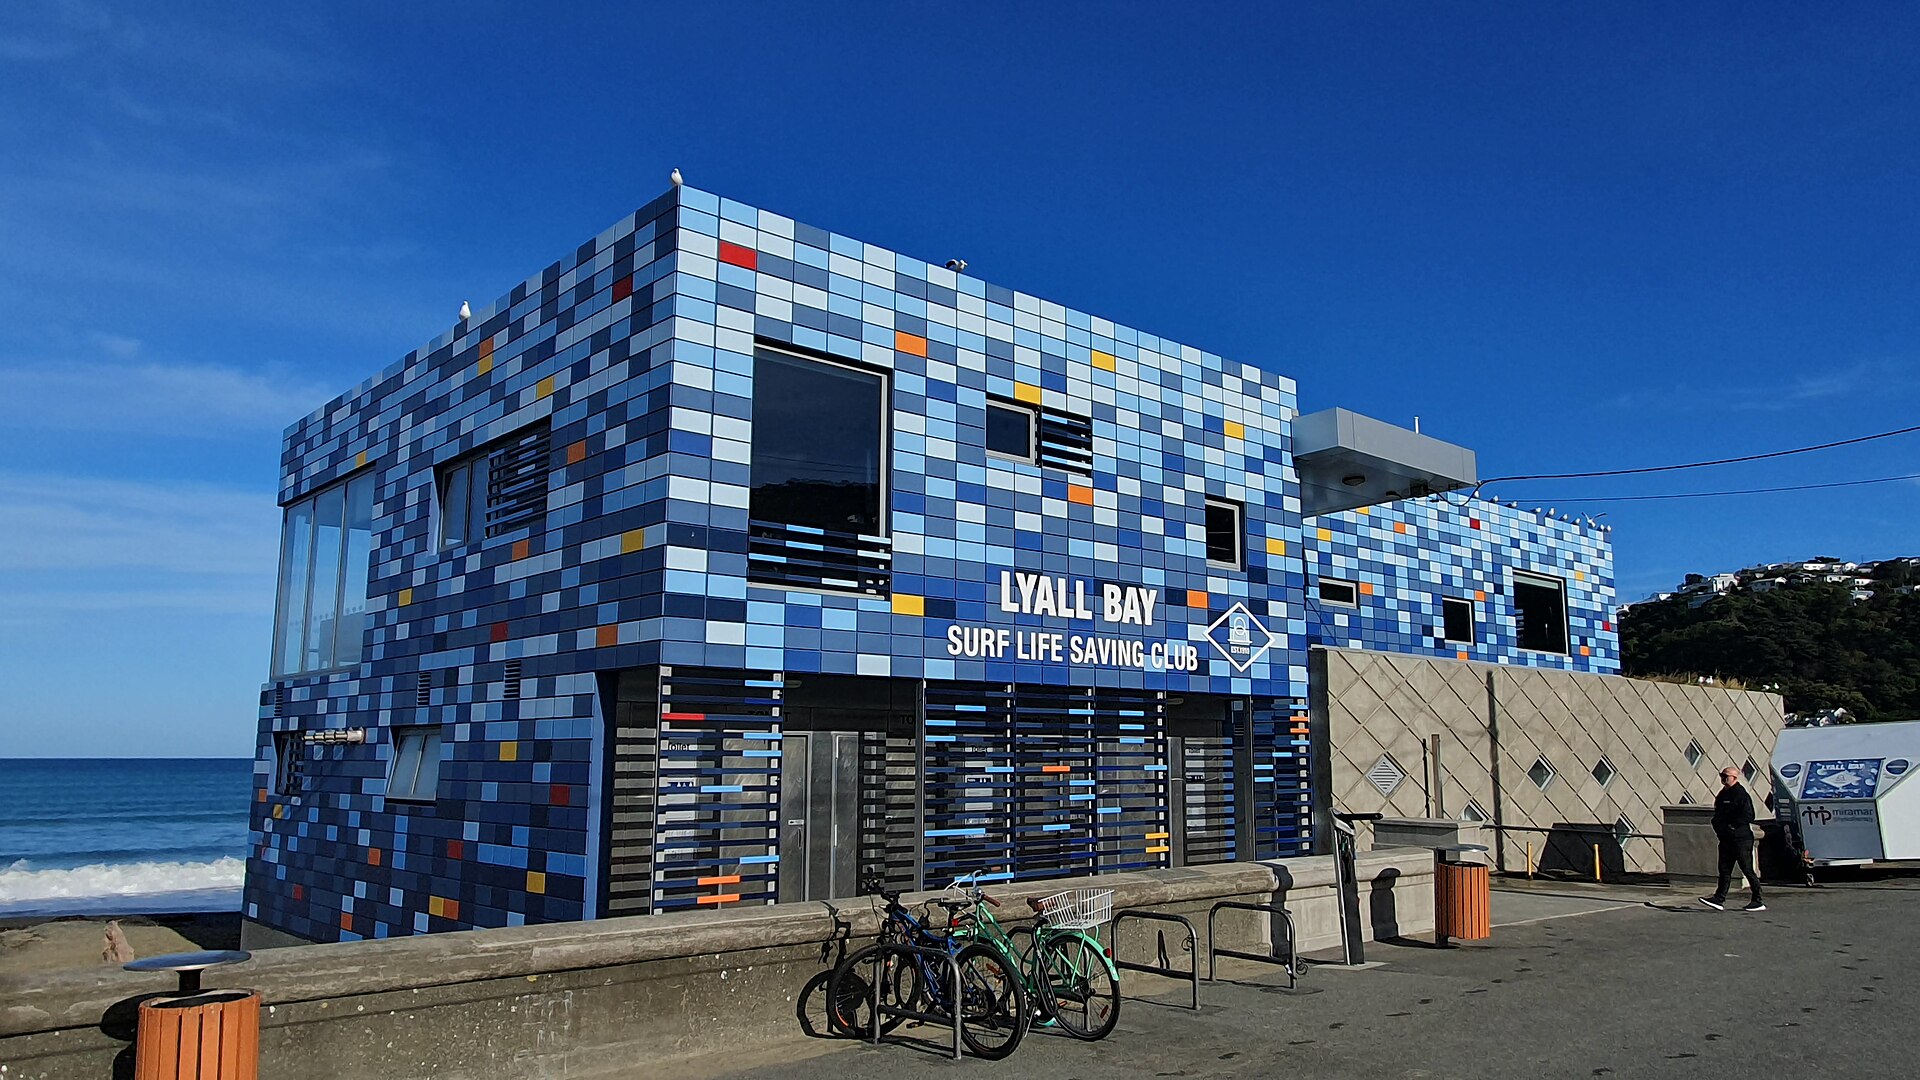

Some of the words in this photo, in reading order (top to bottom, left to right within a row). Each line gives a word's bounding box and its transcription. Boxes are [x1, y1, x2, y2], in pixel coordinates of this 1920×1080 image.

[1000, 570, 1093, 620] LYALL
[1103, 583, 1158, 626] BAY
[947, 625, 1010, 657] SURF
[1017, 631, 1064, 662] LIFE
[1070, 635, 1145, 668] SAVING
[1151, 642, 1198, 672] CLUB
